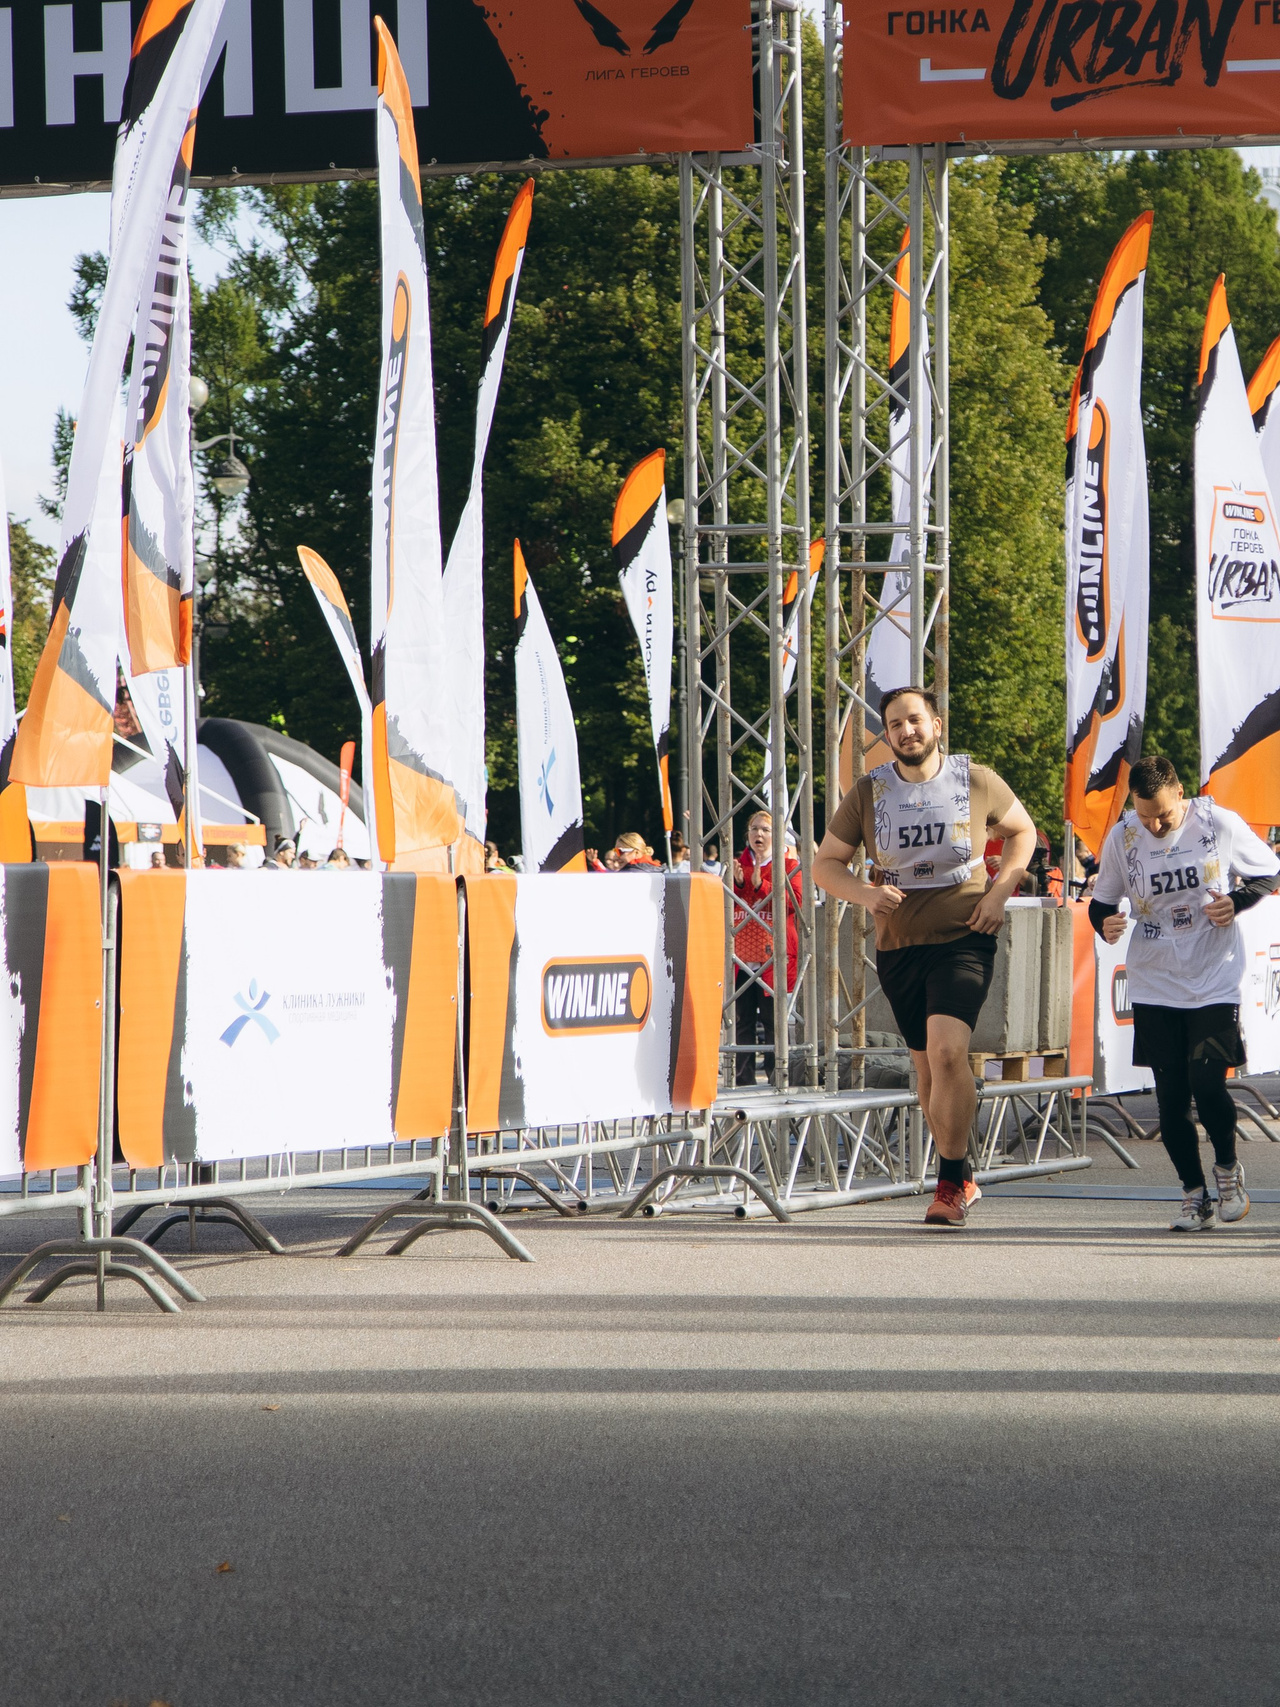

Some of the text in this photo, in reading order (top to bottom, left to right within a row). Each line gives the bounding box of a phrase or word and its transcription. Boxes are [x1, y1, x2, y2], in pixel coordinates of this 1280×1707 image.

[887, 9, 991, 36] ГОНКА
[0, 0, 429, 128] НИШ
[991, 0, 1239, 101] URBAN
[585, 65, 690, 81] ЛИГА ГЕРОЕВ
[1225, 504, 1256, 521] WINLINE
[1230, 541, 1264, 554] ГЕРОЕВ
[1234, 528, 1260, 541] ГОНКА
[898, 822, 946, 849] 5217
[1150, 866, 1200, 896] 5218
[282, 992, 366, 1010] КЛИНИКА ЛУЖНИКИ
[547, 972, 629, 1019] WINLINE
